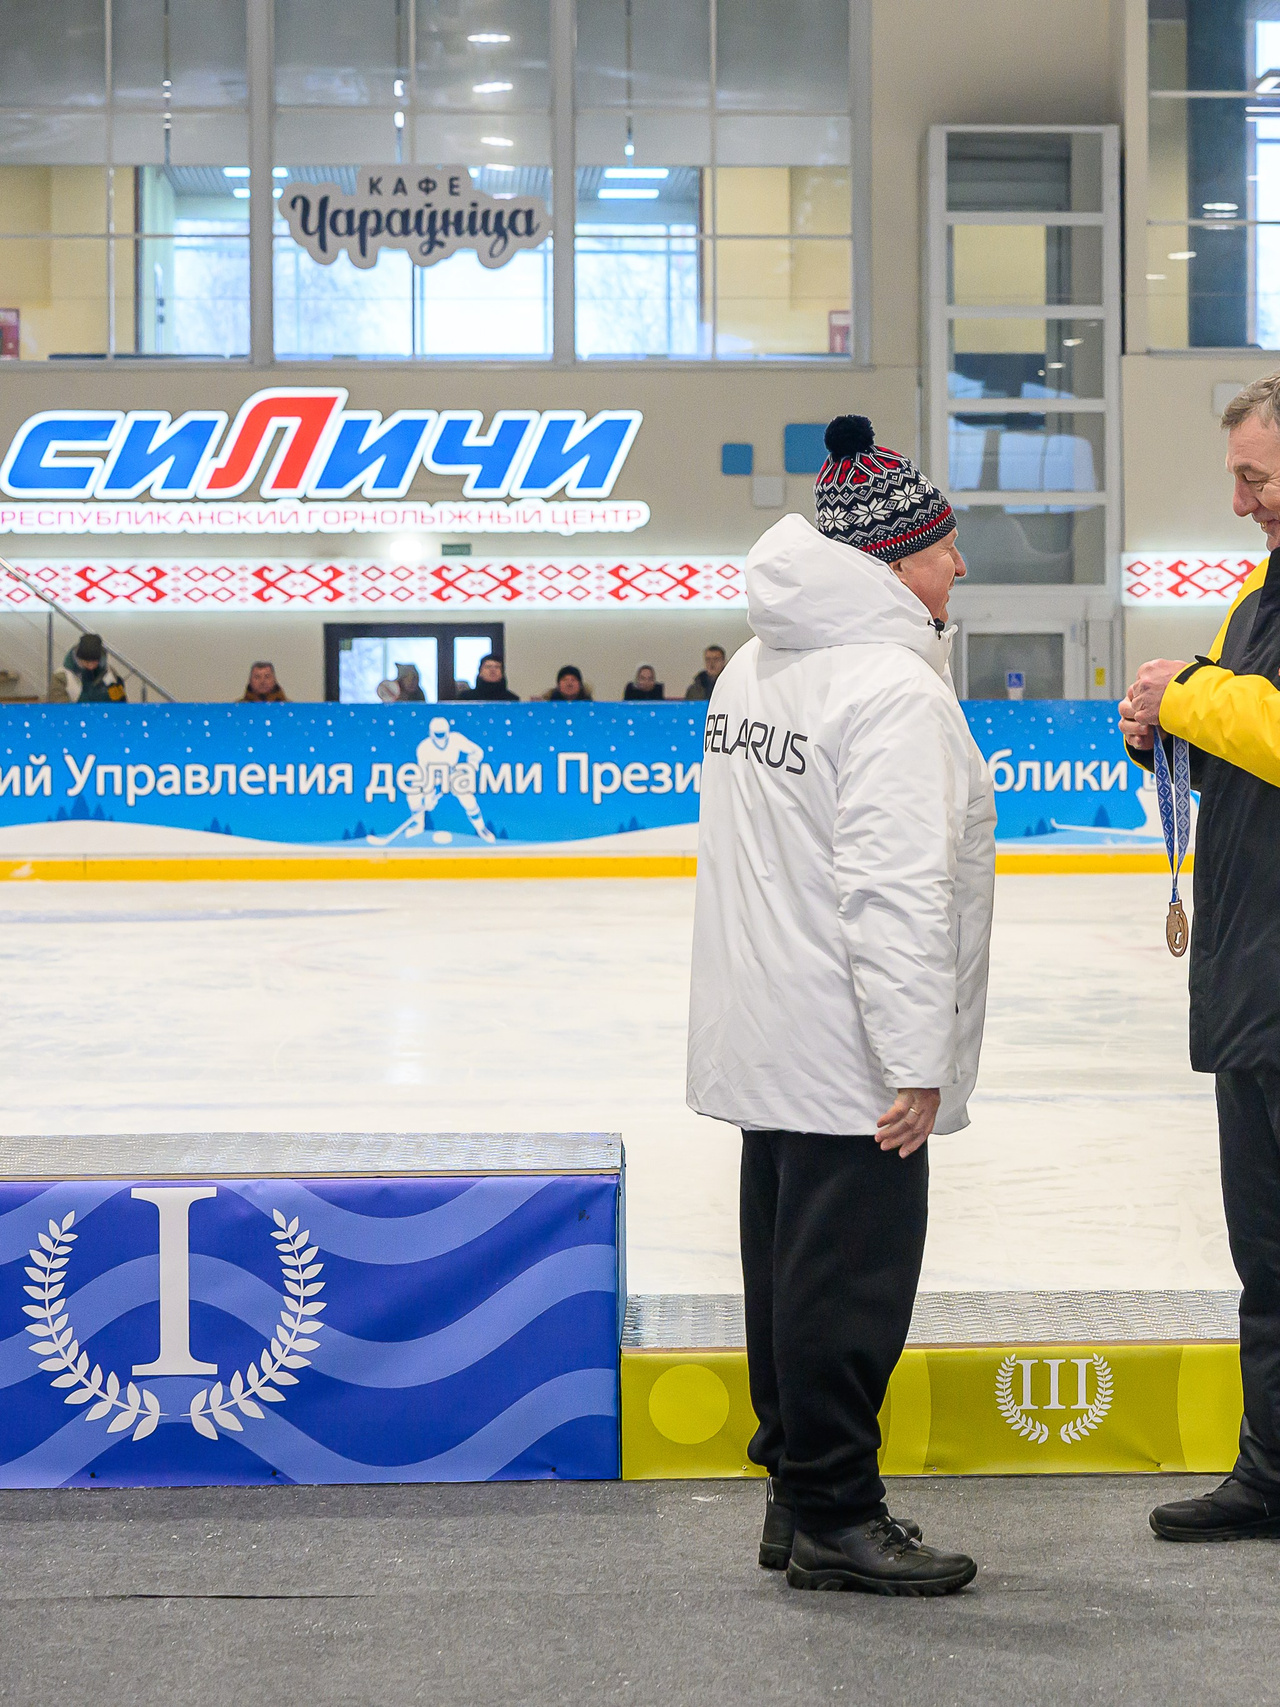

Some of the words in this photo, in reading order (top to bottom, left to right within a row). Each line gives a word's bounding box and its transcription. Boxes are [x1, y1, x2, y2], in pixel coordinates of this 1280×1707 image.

[369, 177, 460, 196] КАФЕ
[291, 195, 539, 258] Чараўніца
[1, 506, 299, 526] РЕСПУБЛИКАНСКИЙ
[307, 505, 541, 525] ГОРНОЛЫЖНЫЙ
[551, 509, 641, 527] ЦЕНТР
[704, 713, 808, 775] BELARUS
[64, 754, 353, 806] Управления
[365, 762, 543, 802] делами
[1015, 1358, 1095, 1410] III
